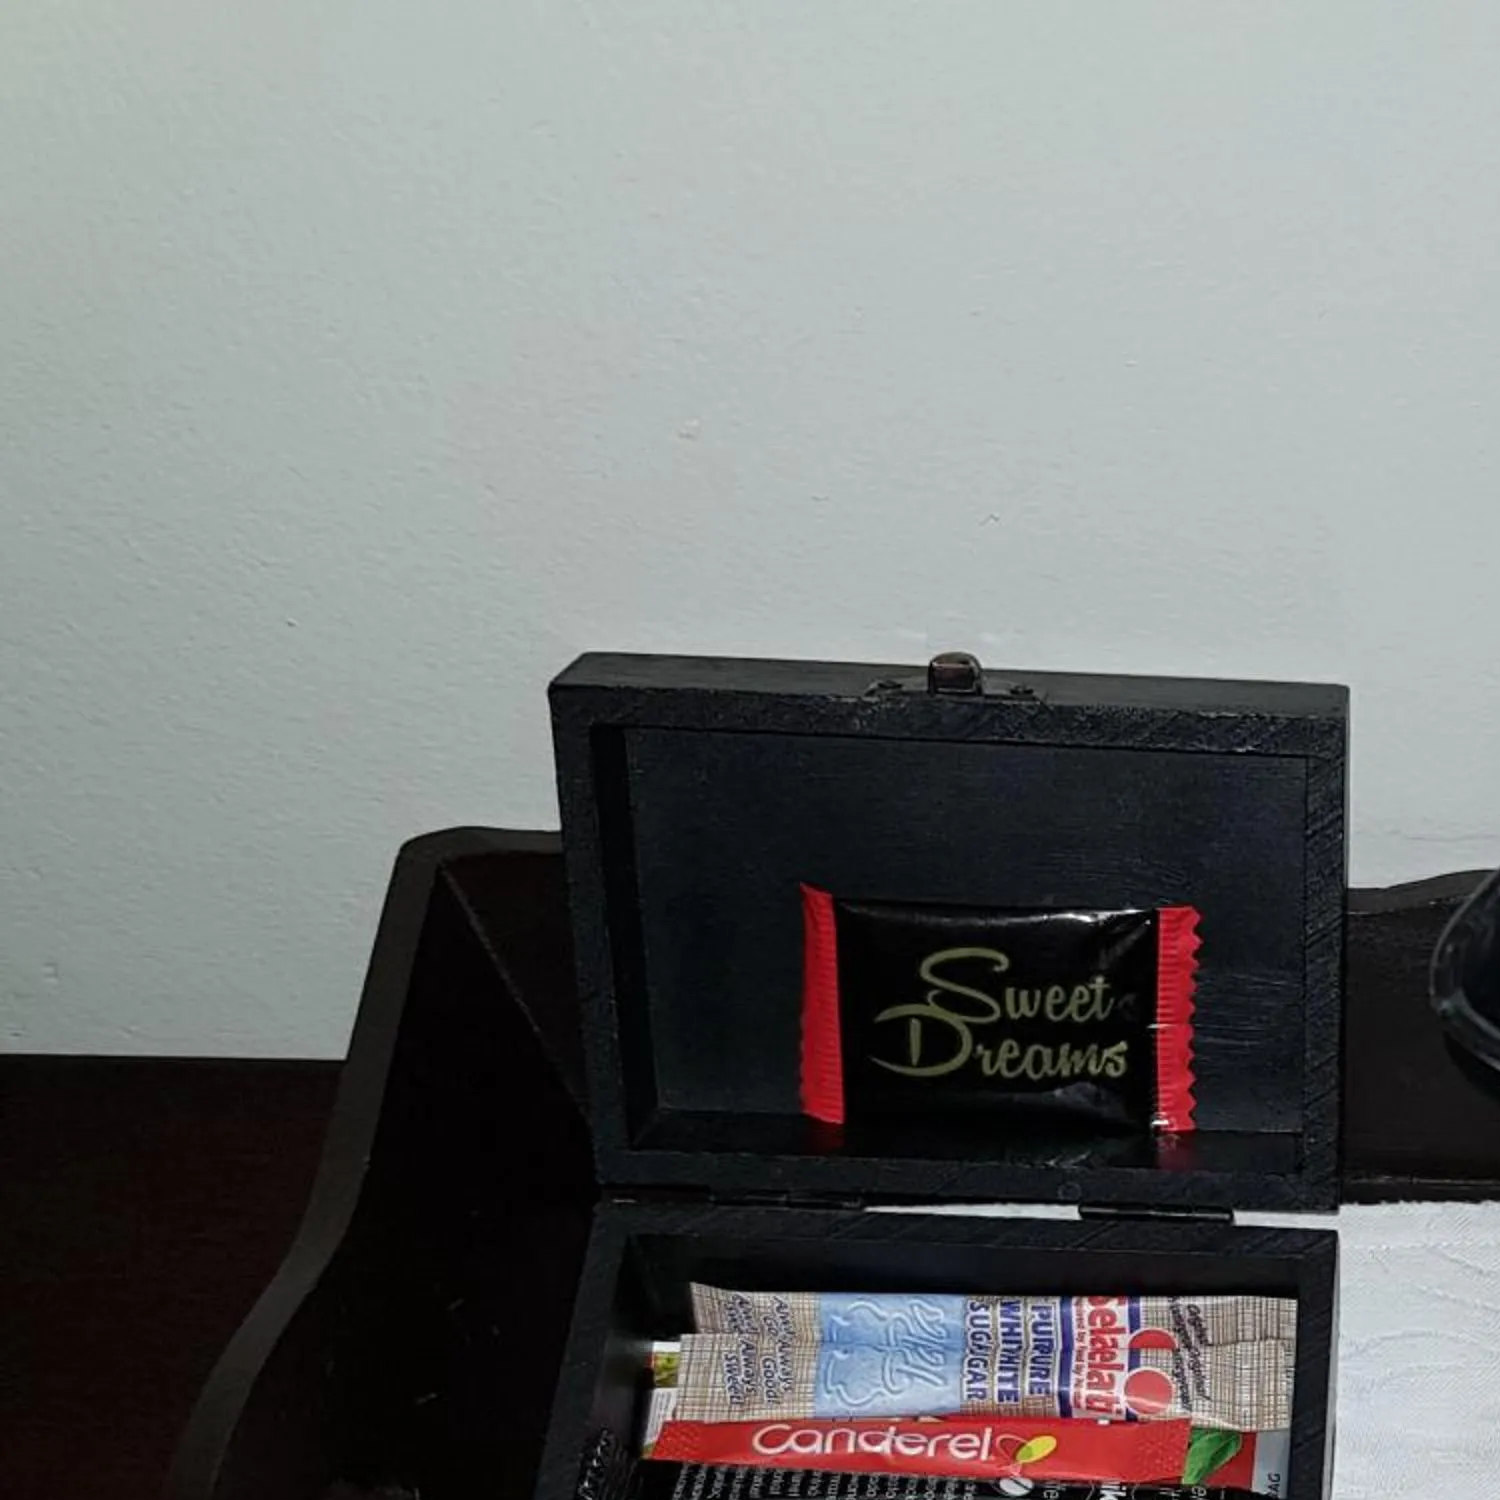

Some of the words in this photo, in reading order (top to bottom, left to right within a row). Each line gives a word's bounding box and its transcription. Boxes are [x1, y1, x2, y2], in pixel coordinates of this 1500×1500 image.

[920, 947, 1114, 1024] Sweet
[867, 1003, 1129, 1080] Dreams
[752, 1423, 993, 1461] Canderel
